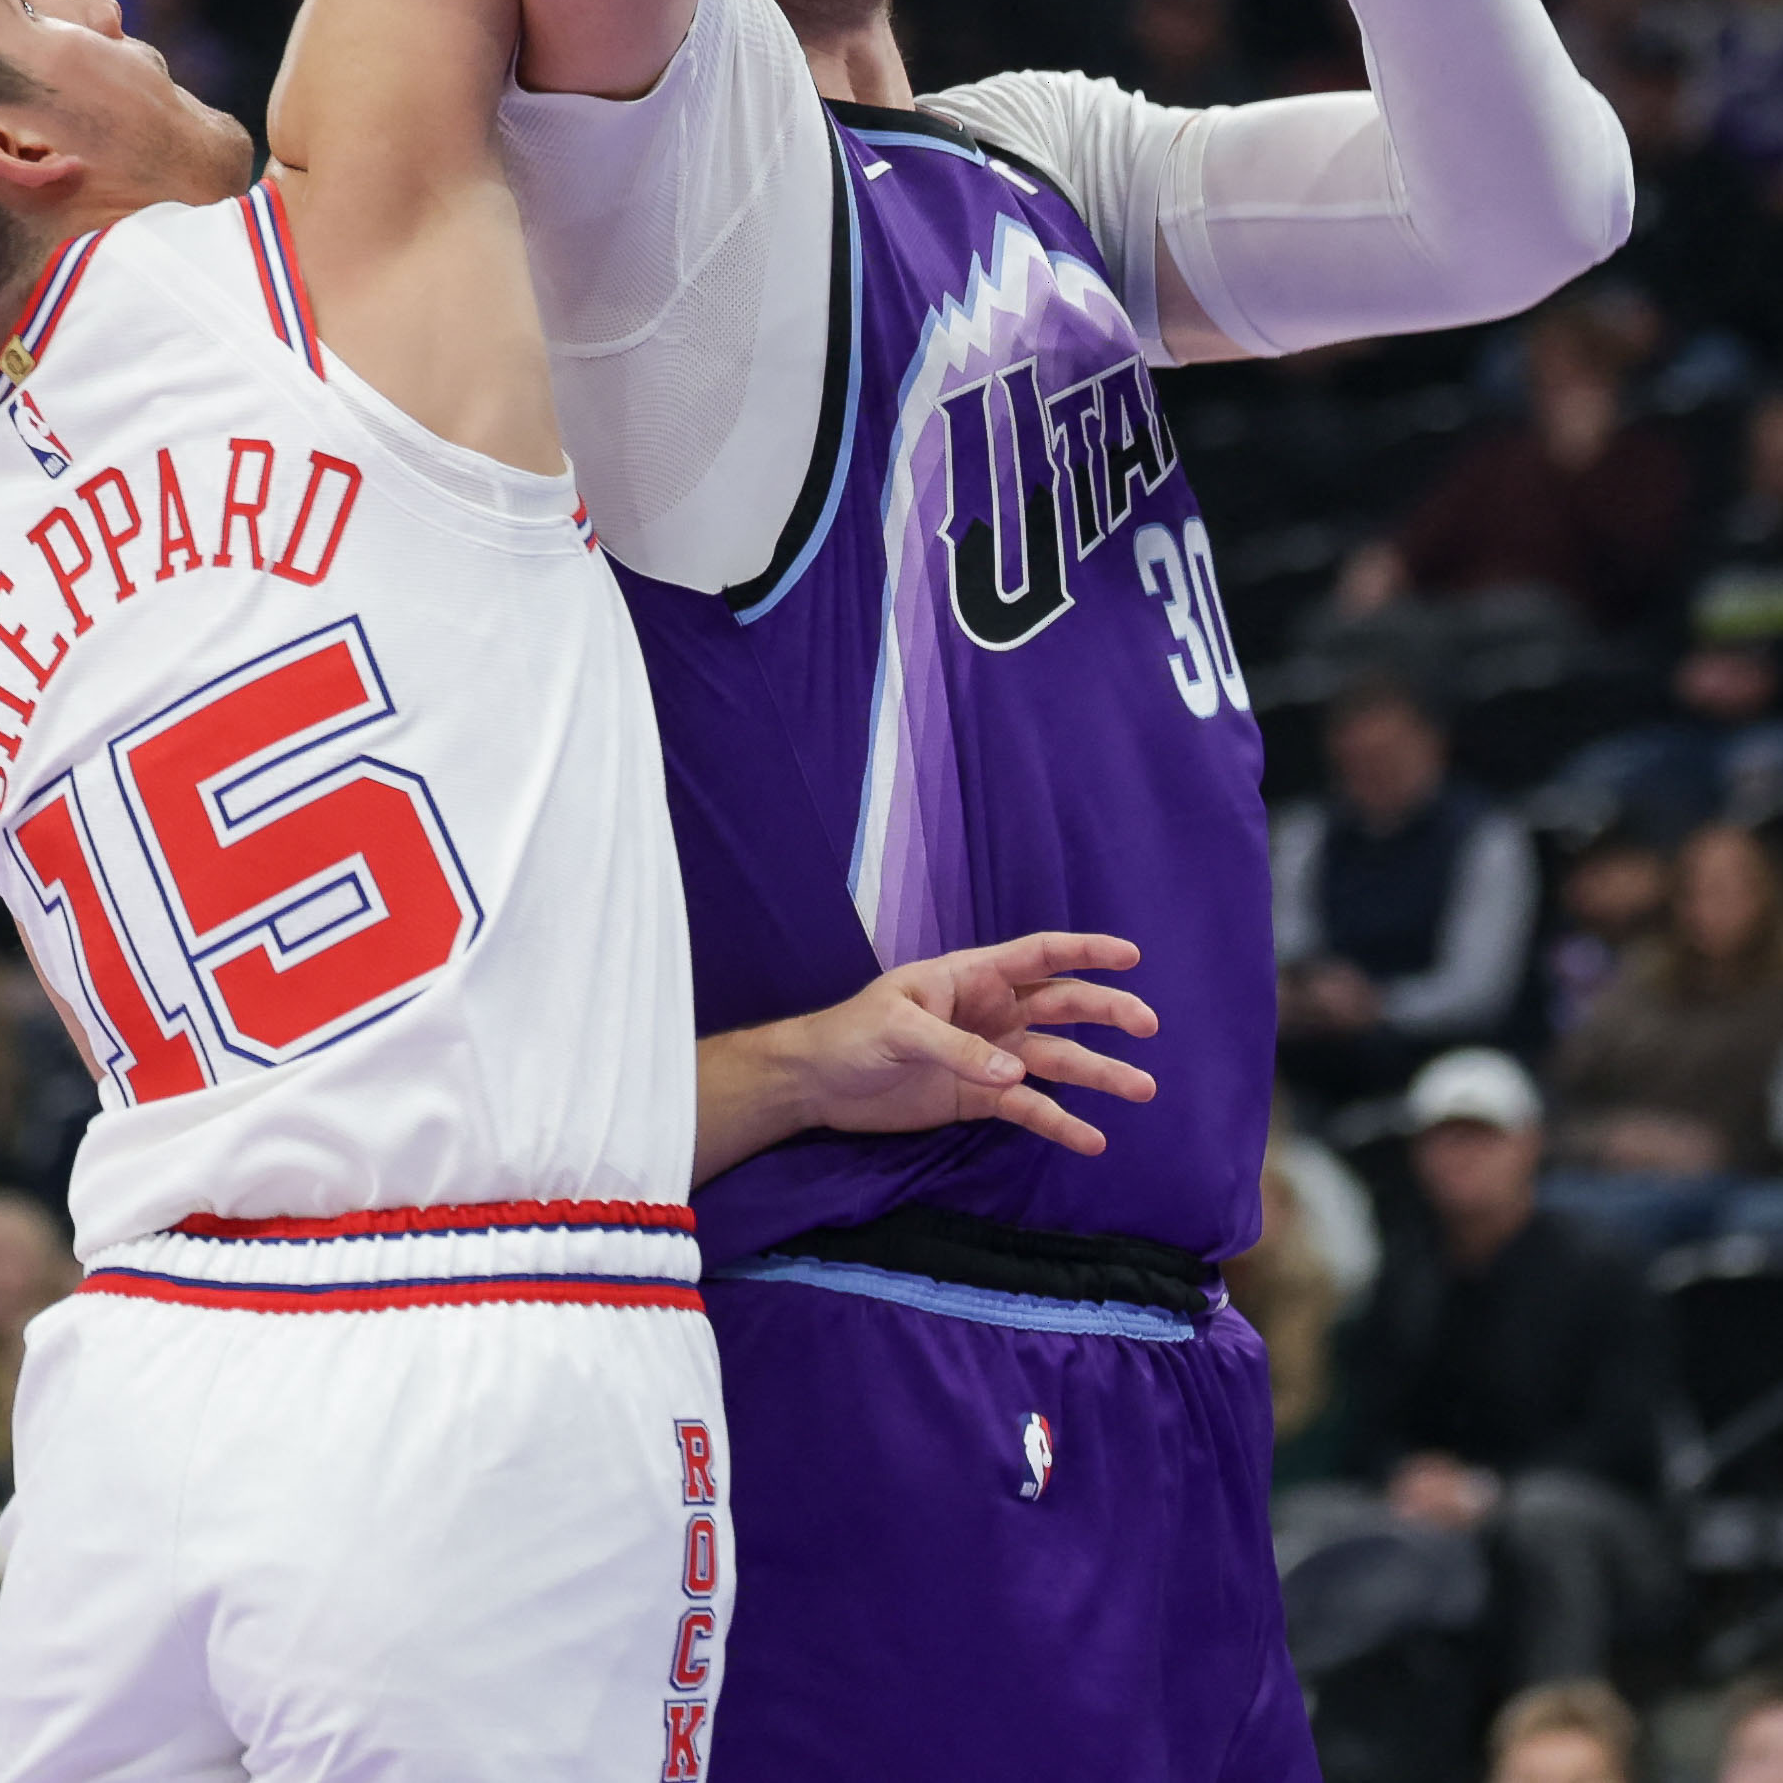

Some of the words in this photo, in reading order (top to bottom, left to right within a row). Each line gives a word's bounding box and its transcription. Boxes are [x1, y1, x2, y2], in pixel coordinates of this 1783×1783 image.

[1133, 515, 1251, 720] 30
[4, 614, 485, 1109] 15
[661, 1418, 719, 1782] ROCK
